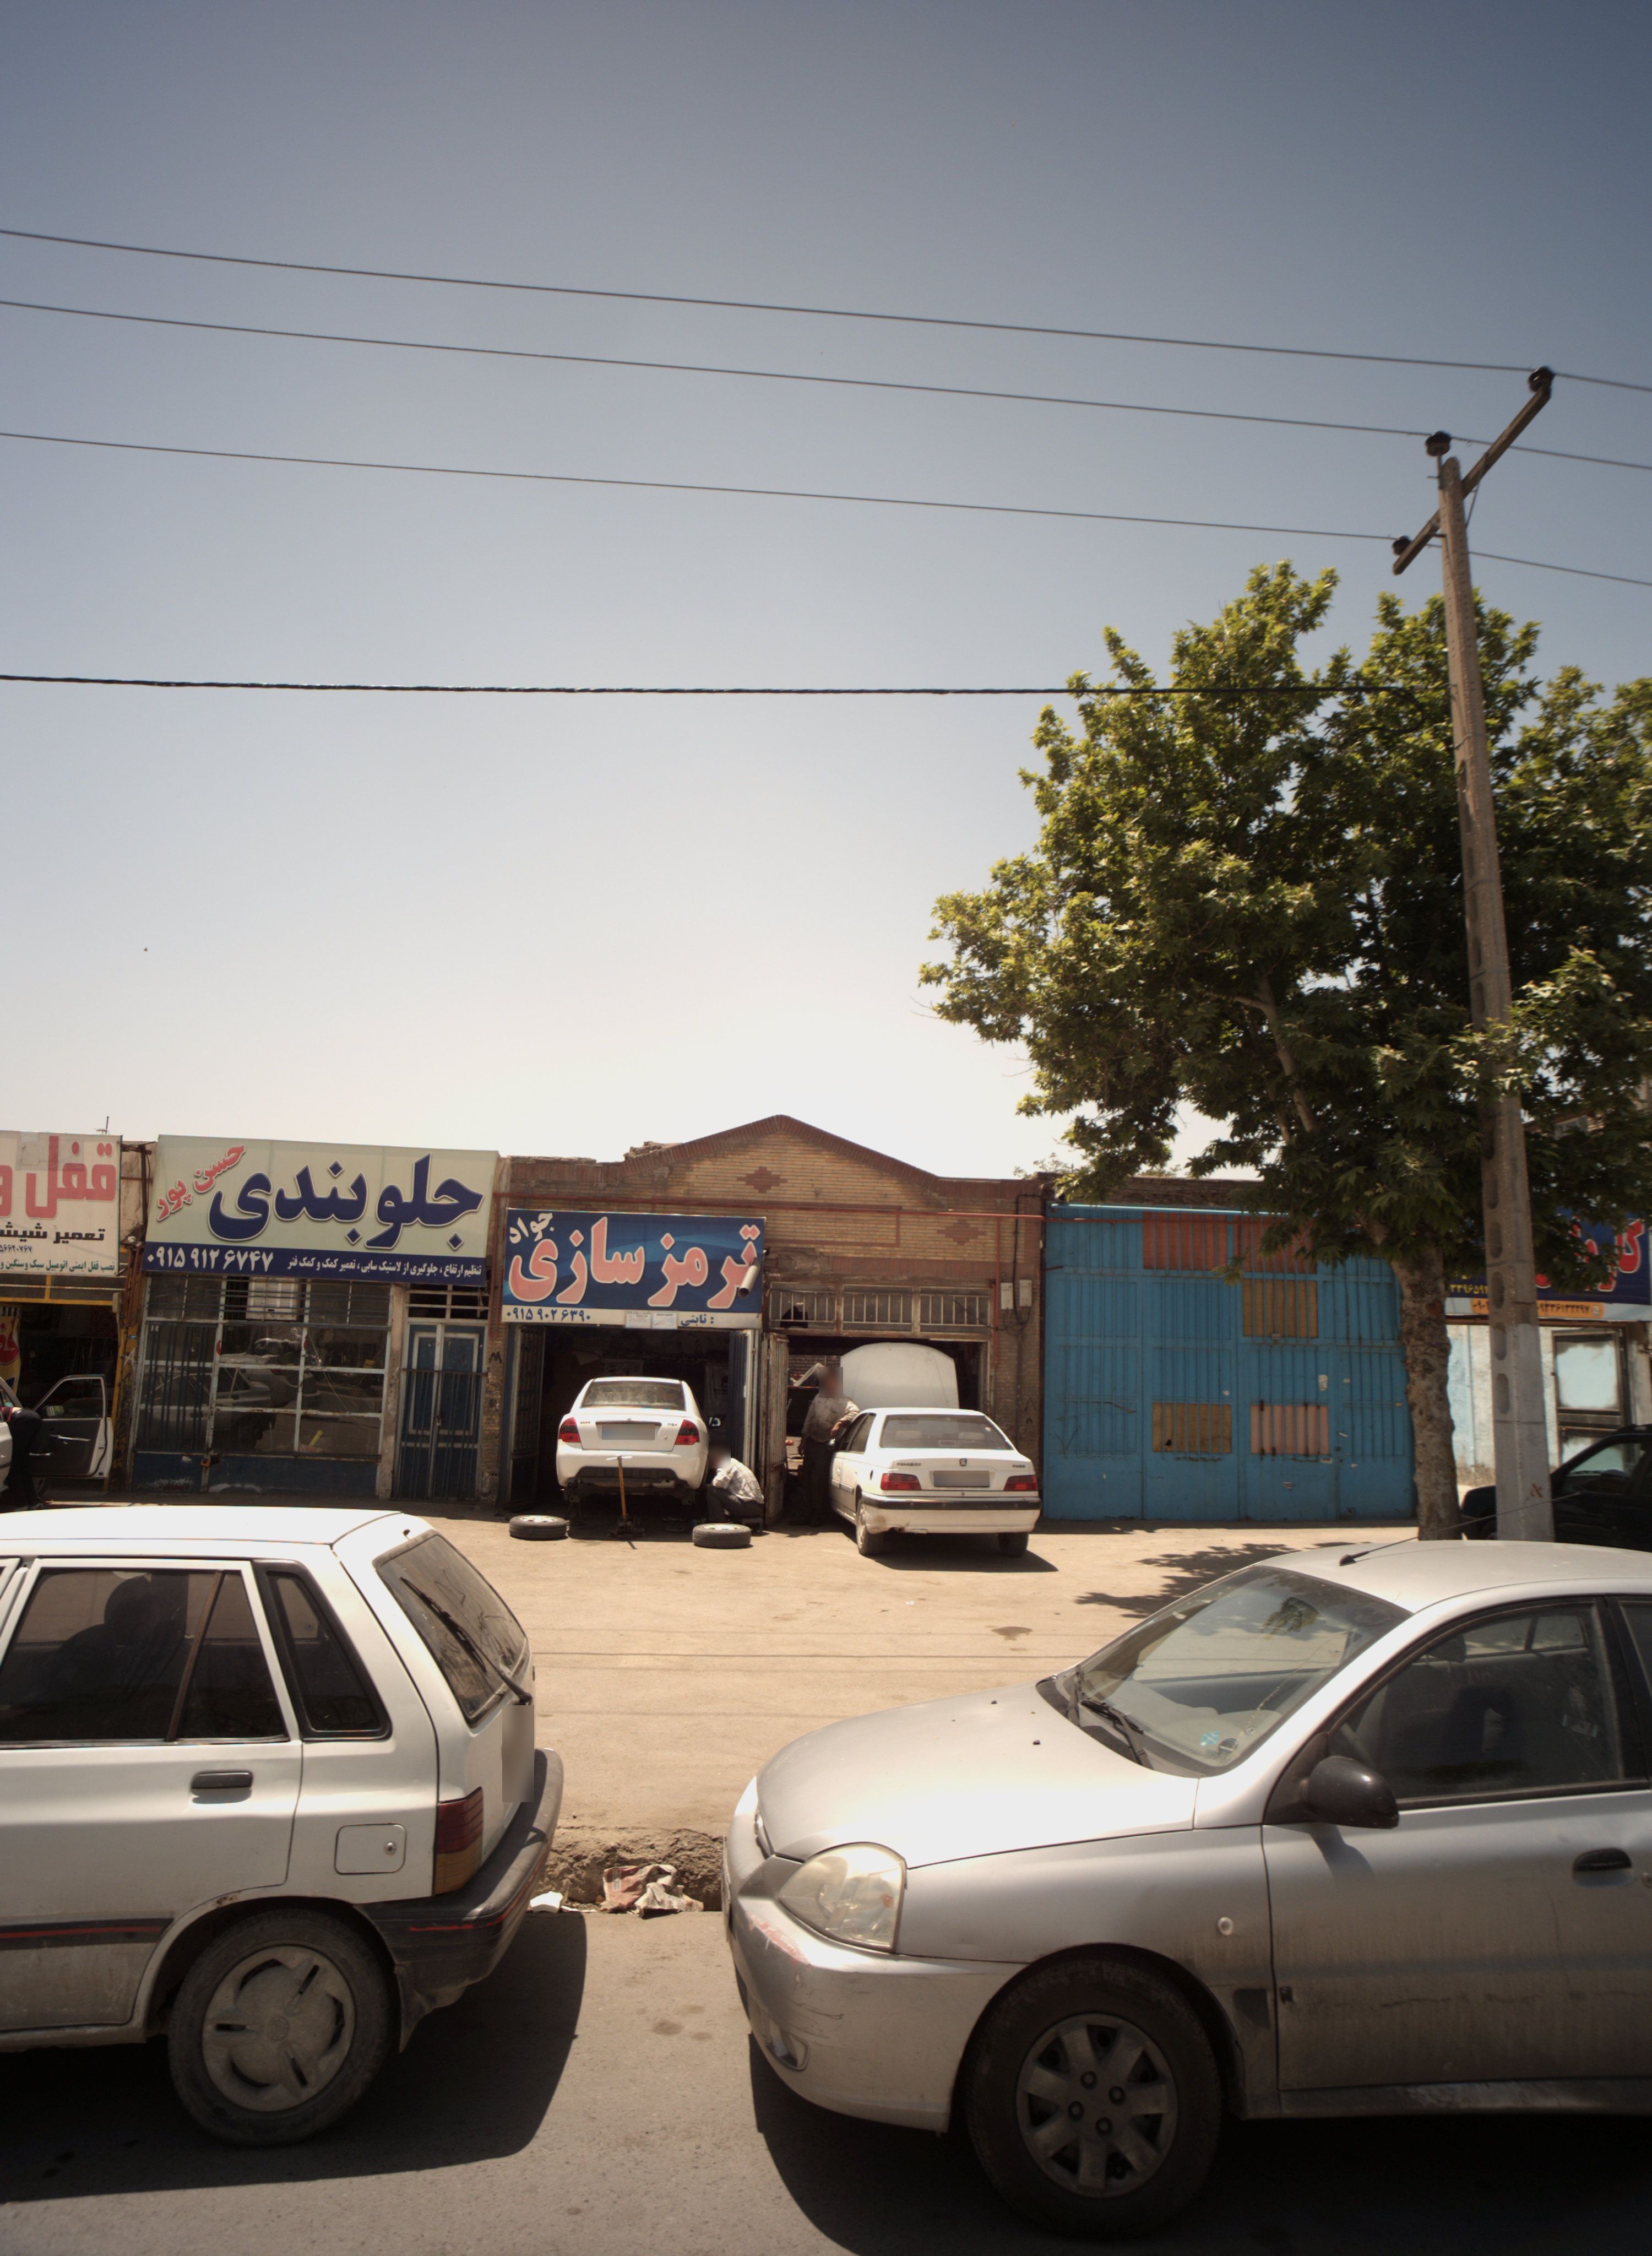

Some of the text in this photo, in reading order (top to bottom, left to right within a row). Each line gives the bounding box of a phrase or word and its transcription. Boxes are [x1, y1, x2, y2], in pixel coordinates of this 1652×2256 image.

[25, 1135, 116, 1219] قفل
[157, 1145, 246, 1221] حسن پور
[0, 1221, 105, 1244] تعمیر شیش
[509, 1212, 553, 1244] جواد
[30, 1259, 45, 1270] سبک
[88, 1260, 99, 1272] قفل
[147, 1246, 274, 1272] ۰۹۱۵ ۹۱۲ ۶۷۴۷
[287, 1255, 298, 1270] فنر
[299, 1256, 316, 1267] کمک
[316, 1261, 320, 1271] و
[322, 1257, 339, 1268] کمک
[339, 1259, 356, 1272] تعمیر
[508, 1216, 645, 1304] سازی
[100, 1264, 115, 1272] نصب
[379, 1260, 401, 1273] لاستیک
[402, 1261, 410, 1275] از
[410, 1262, 438, 1276] جلوگیری
[464, 1265, 482, 1278] تنظیم
[507, 1307, 591, 1322] ۰۹۱۵ ۹۰۲ ۶۳۹۰
